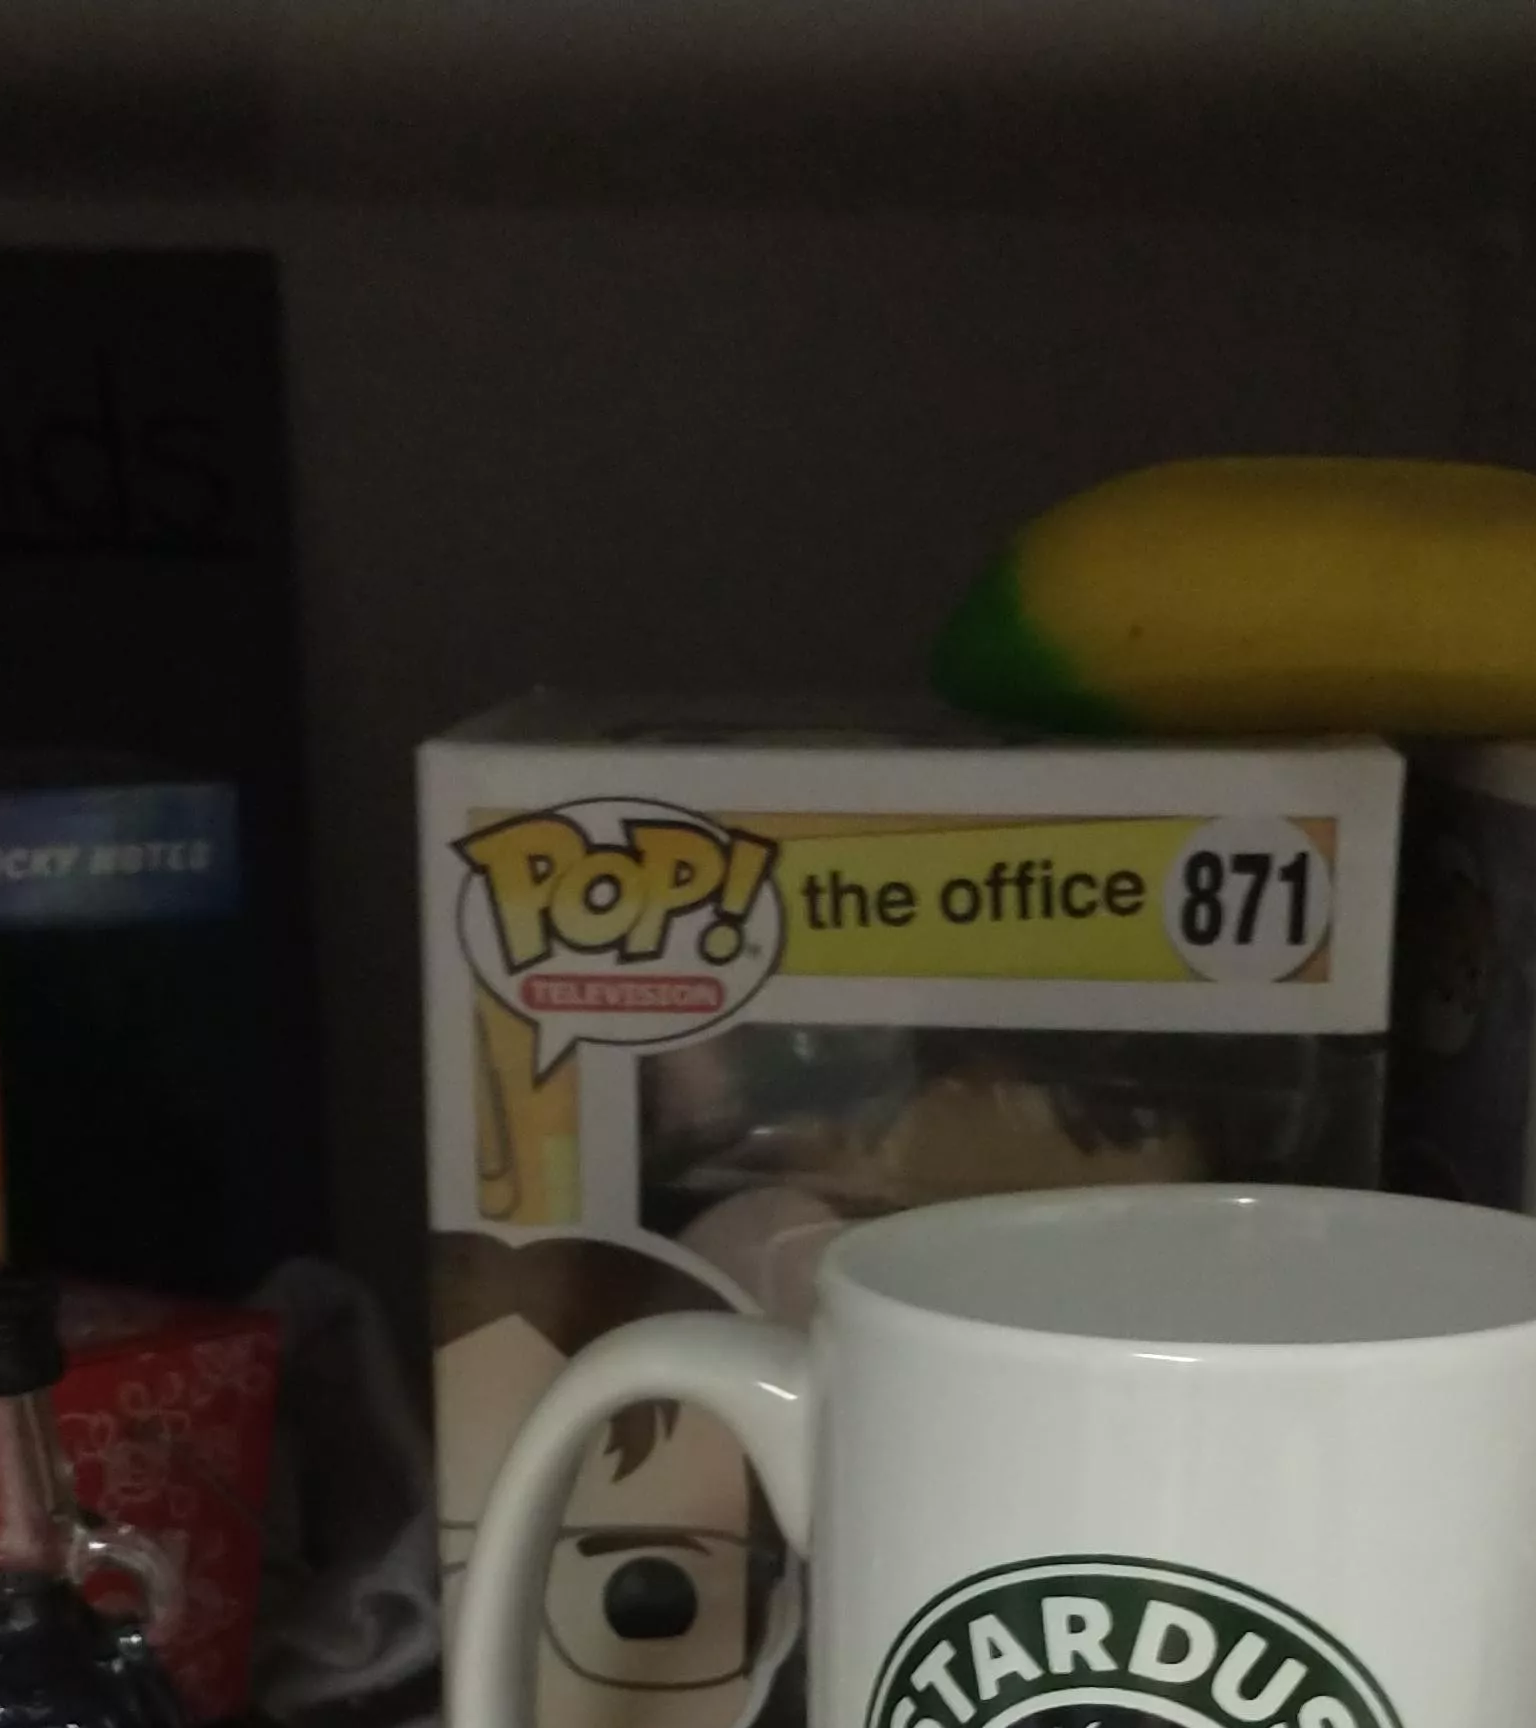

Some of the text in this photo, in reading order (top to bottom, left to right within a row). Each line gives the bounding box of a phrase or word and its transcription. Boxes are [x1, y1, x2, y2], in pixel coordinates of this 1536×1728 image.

[86, 836, 212, 879] NOTES
[448, 812, 780, 976] POP!
[803, 864, 1147, 931] the office
[1179, 848, 1312, 947] 871
[528, 976, 722, 1010] TELEVISION
